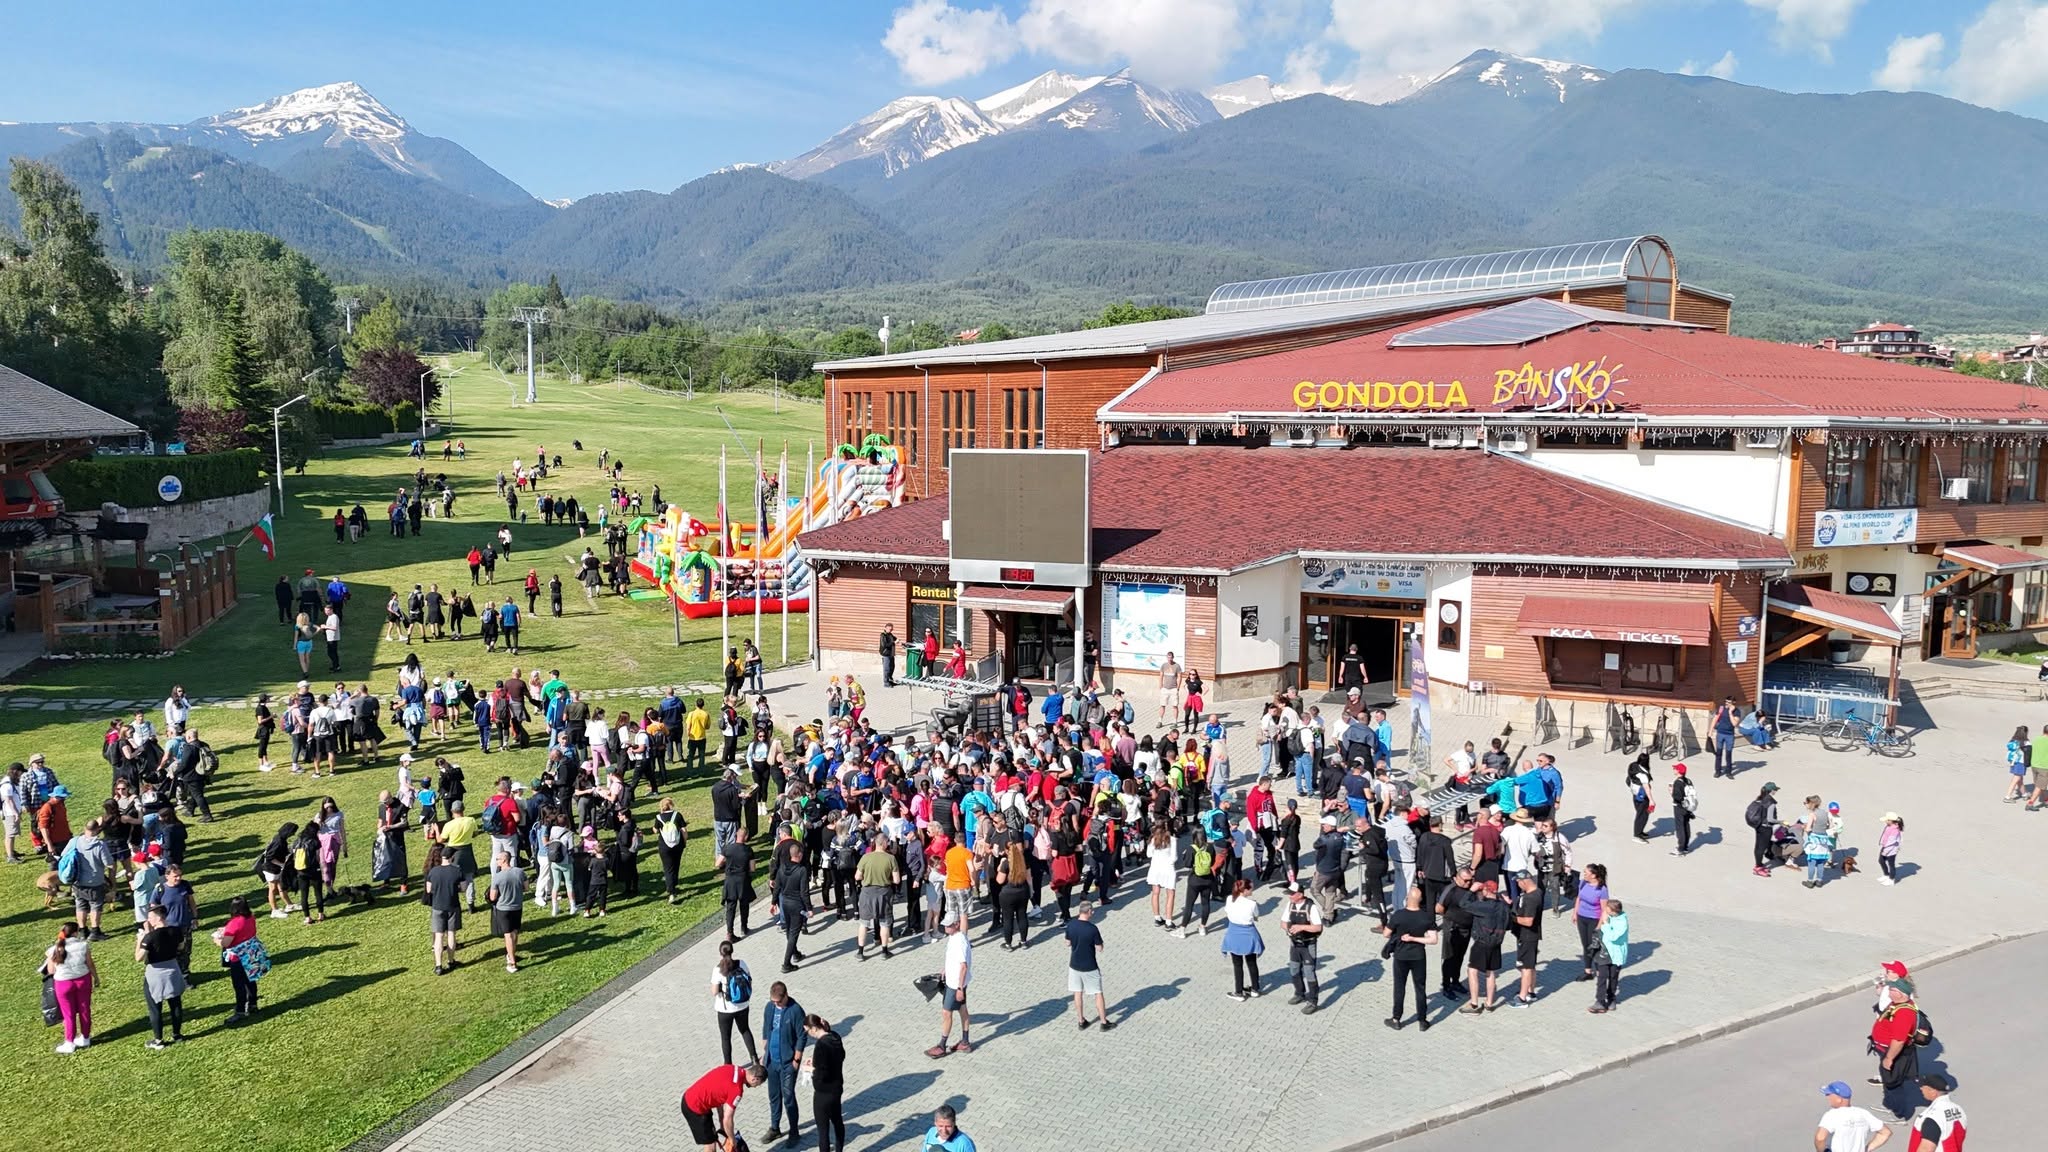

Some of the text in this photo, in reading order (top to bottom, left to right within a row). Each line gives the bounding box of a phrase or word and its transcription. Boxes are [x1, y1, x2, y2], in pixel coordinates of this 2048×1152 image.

[1293, 361, 1613, 411] GONDOLA BANSKO
[912, 585, 950, 598] Rental
[1617, 631, 1683, 644] TICKETS
